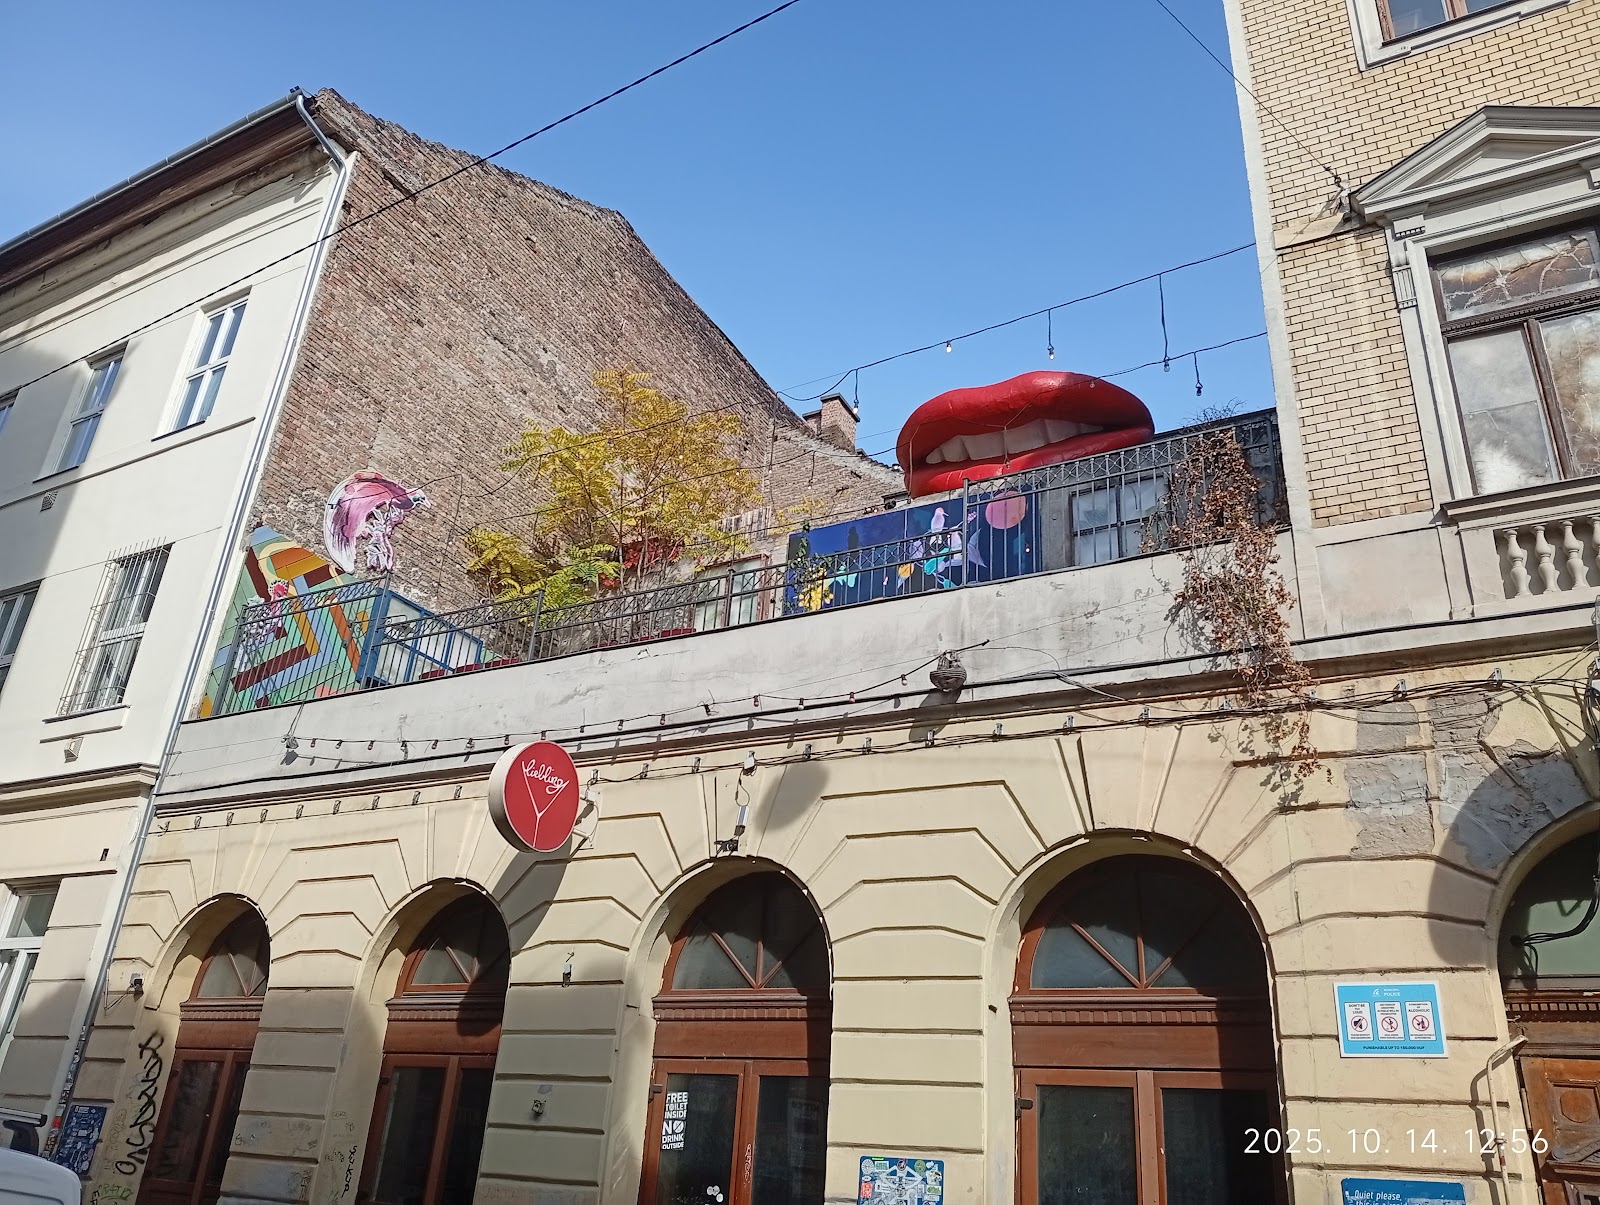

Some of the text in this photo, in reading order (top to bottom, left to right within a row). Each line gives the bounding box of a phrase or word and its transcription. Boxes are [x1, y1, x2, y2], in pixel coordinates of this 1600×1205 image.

[666, 1092, 688, 1104] FREE
[665, 1102, 688, 1111] TOILET
[664, 1110, 687, 1119] INSIDE
[662, 1120, 684, 1135] NO
[662, 1133, 684, 1144] DRINK
[662, 1142, 684, 1150] OUTSIDE
[1354, 1190, 1374, 1199] Quiet
